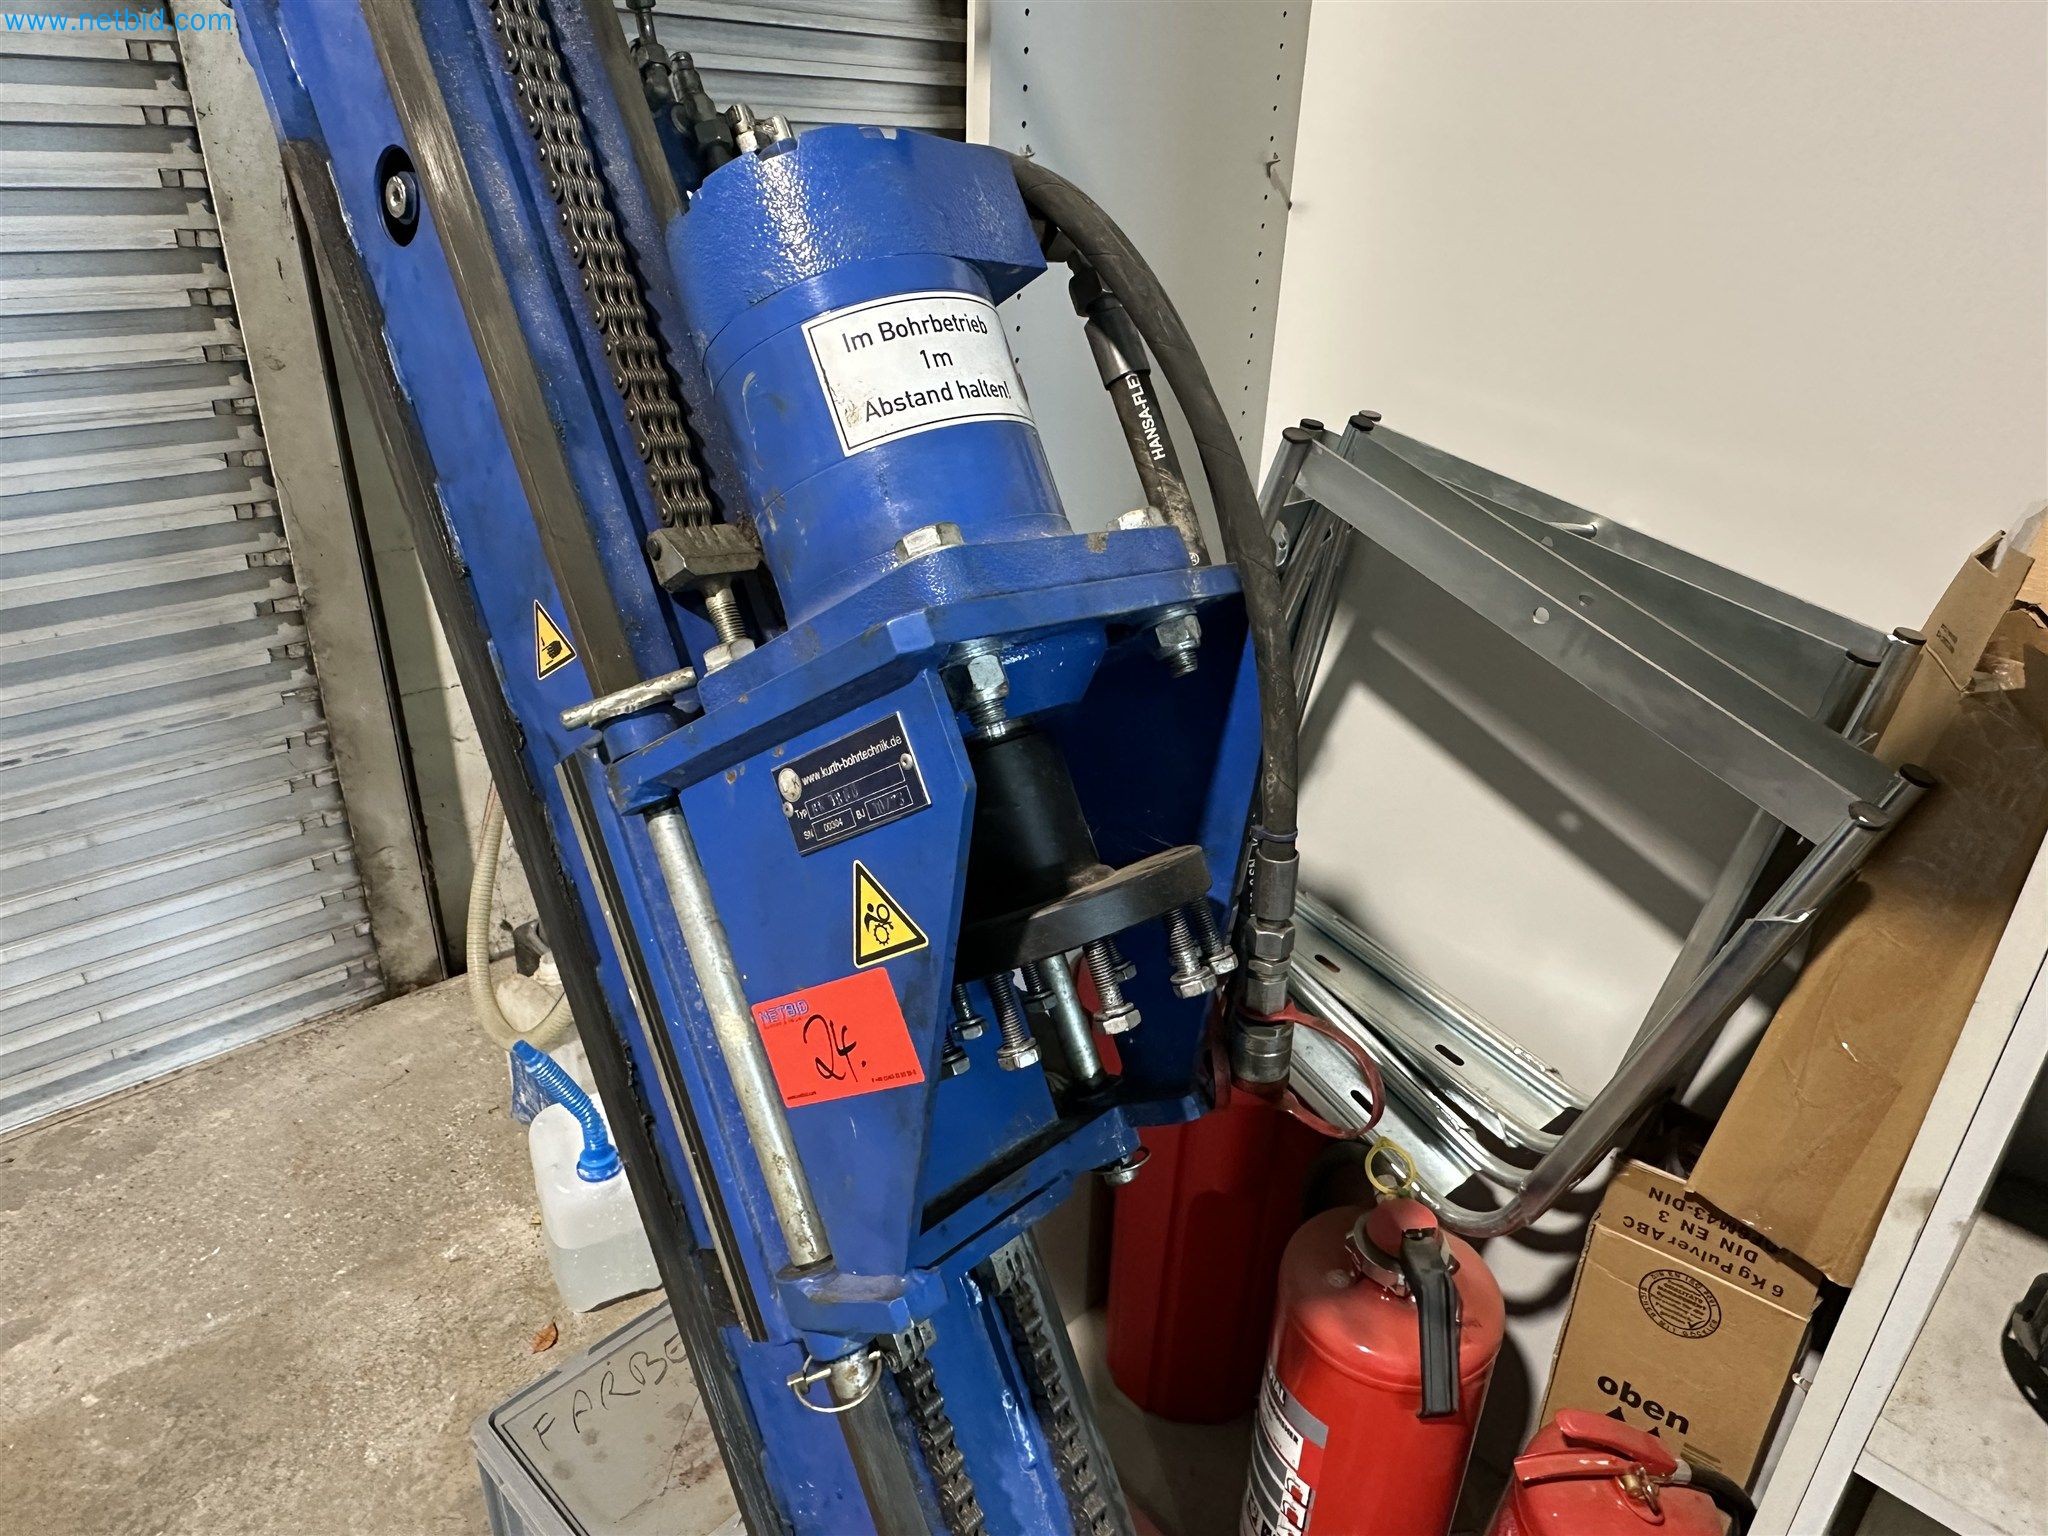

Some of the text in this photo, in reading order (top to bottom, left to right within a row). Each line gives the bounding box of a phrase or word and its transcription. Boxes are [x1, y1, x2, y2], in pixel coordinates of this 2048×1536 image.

[842, 313, 989, 353] Im Bohrbetrieb
[919, 349, 954, 370] 1m
[864, 379, 1011, 422] Abstand halten!
[801, 735, 902, 786] www.kurth-bohrtechnik.de
[795, 809, 808, 820] Typ
[856, 808, 866, 820] BJ
[1623, 1215, 1784, 1298] 6 Kg Pulver ABC
[1658, 1209, 1759, 1264] DIN EN 3
[1597, 1375, 1690, 1435] oben
